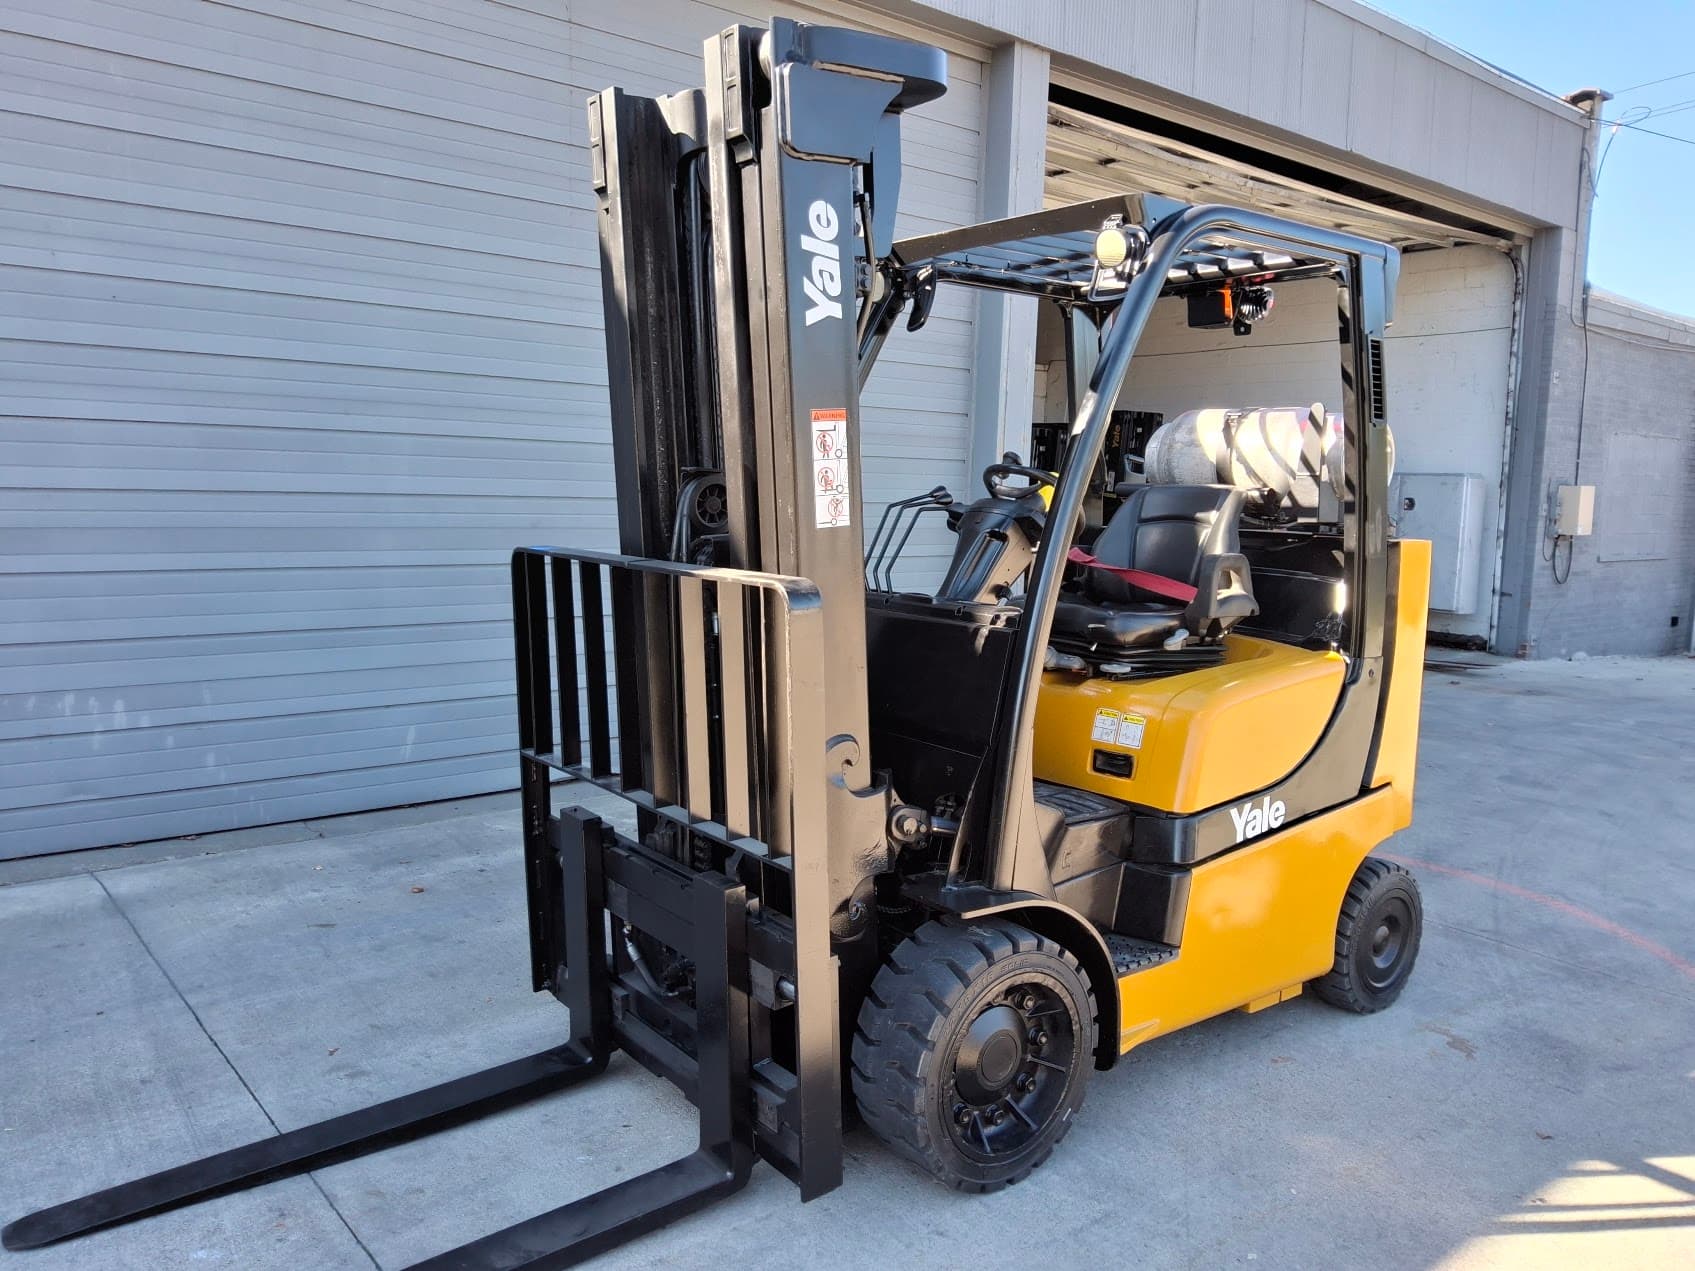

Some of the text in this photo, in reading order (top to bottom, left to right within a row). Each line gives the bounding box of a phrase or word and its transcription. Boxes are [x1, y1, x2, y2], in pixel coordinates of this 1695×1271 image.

[801, 200, 842, 326] Yale
[1112, 425, 1120, 447] Yale
[1230, 796, 1286, 843] Yale
